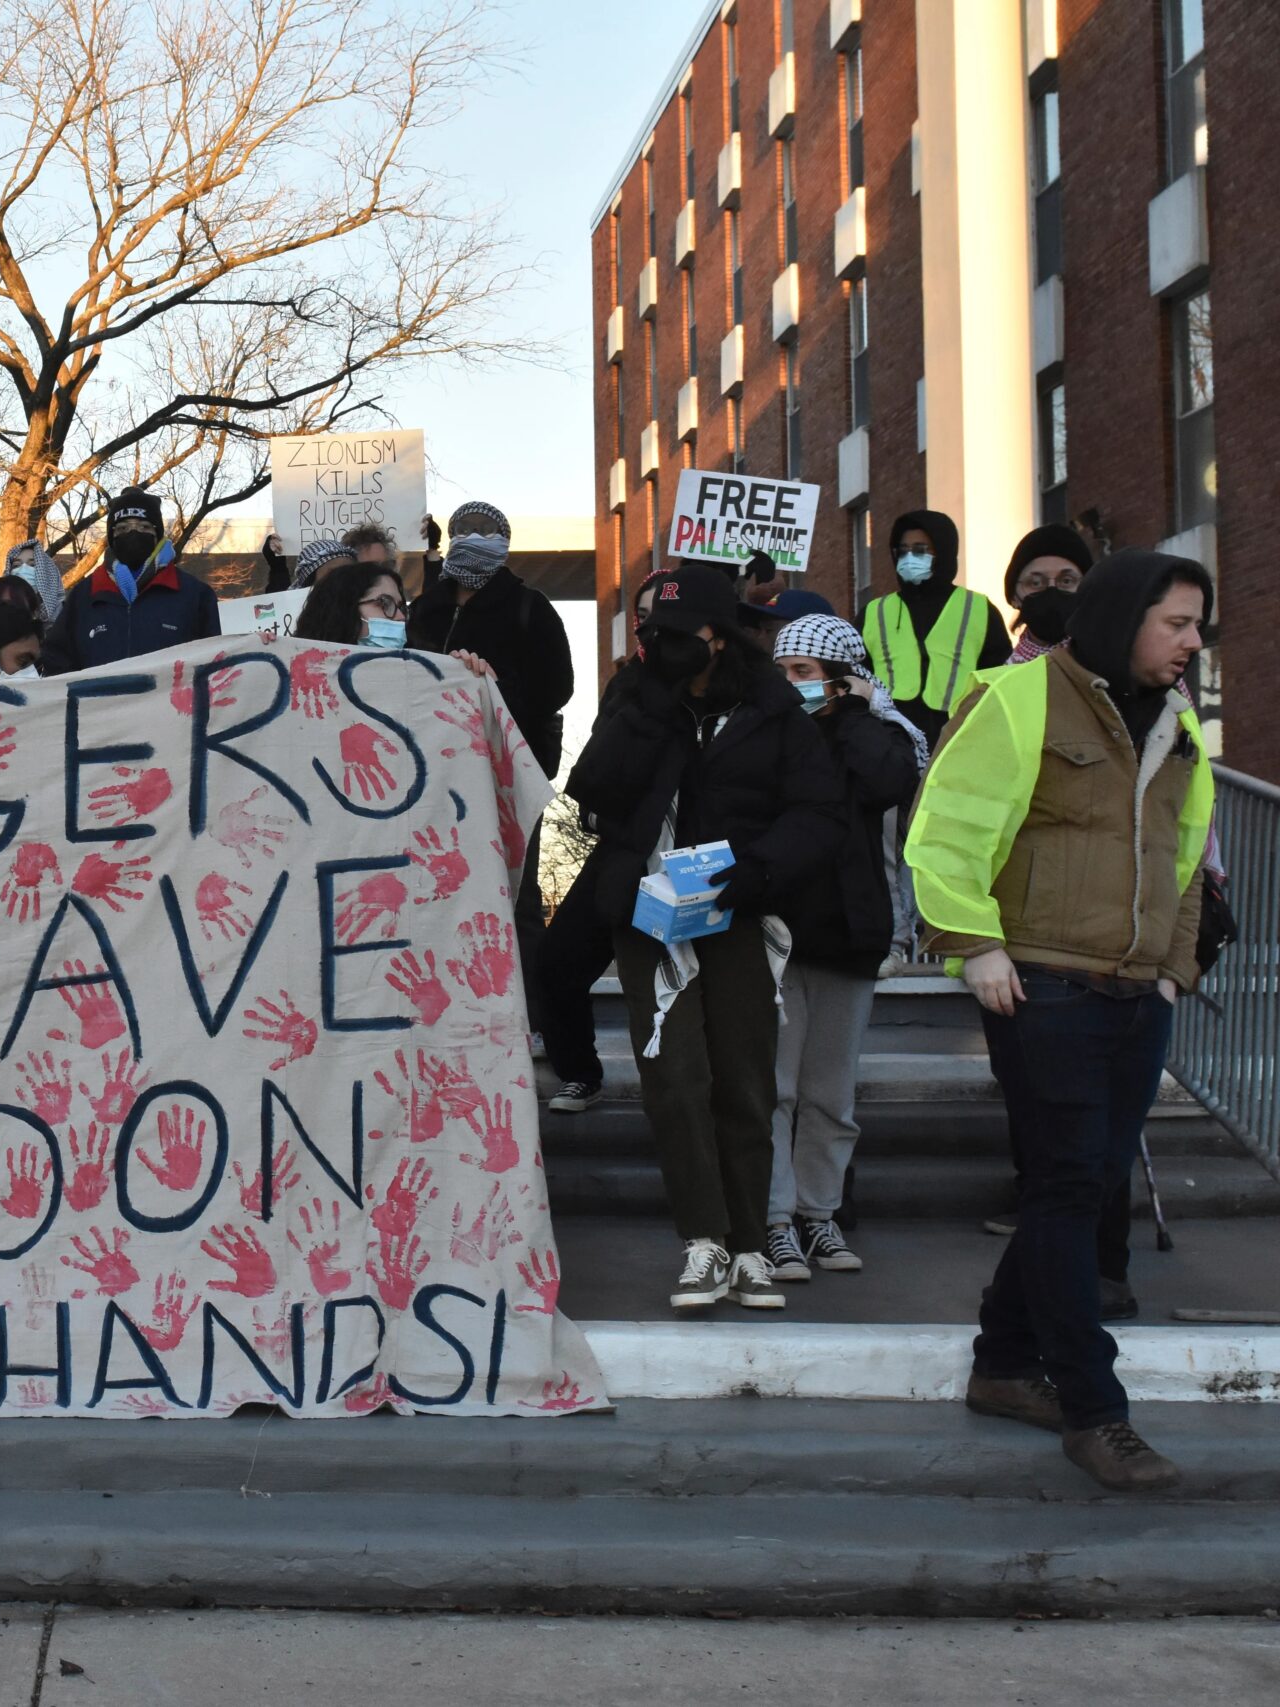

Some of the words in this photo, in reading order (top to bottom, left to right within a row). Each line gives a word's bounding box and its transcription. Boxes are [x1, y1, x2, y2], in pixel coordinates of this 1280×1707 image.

[285, 438, 396, 467] ZIONISM
[315, 468, 383, 496] KILLS
[299, 498, 385, 527] RUTGERS
[696, 476, 801, 525] FREE
[674, 514, 808, 567] PALESTINE
[660, 583, 680, 600] R
[114, 1078, 364, 1233] ON
